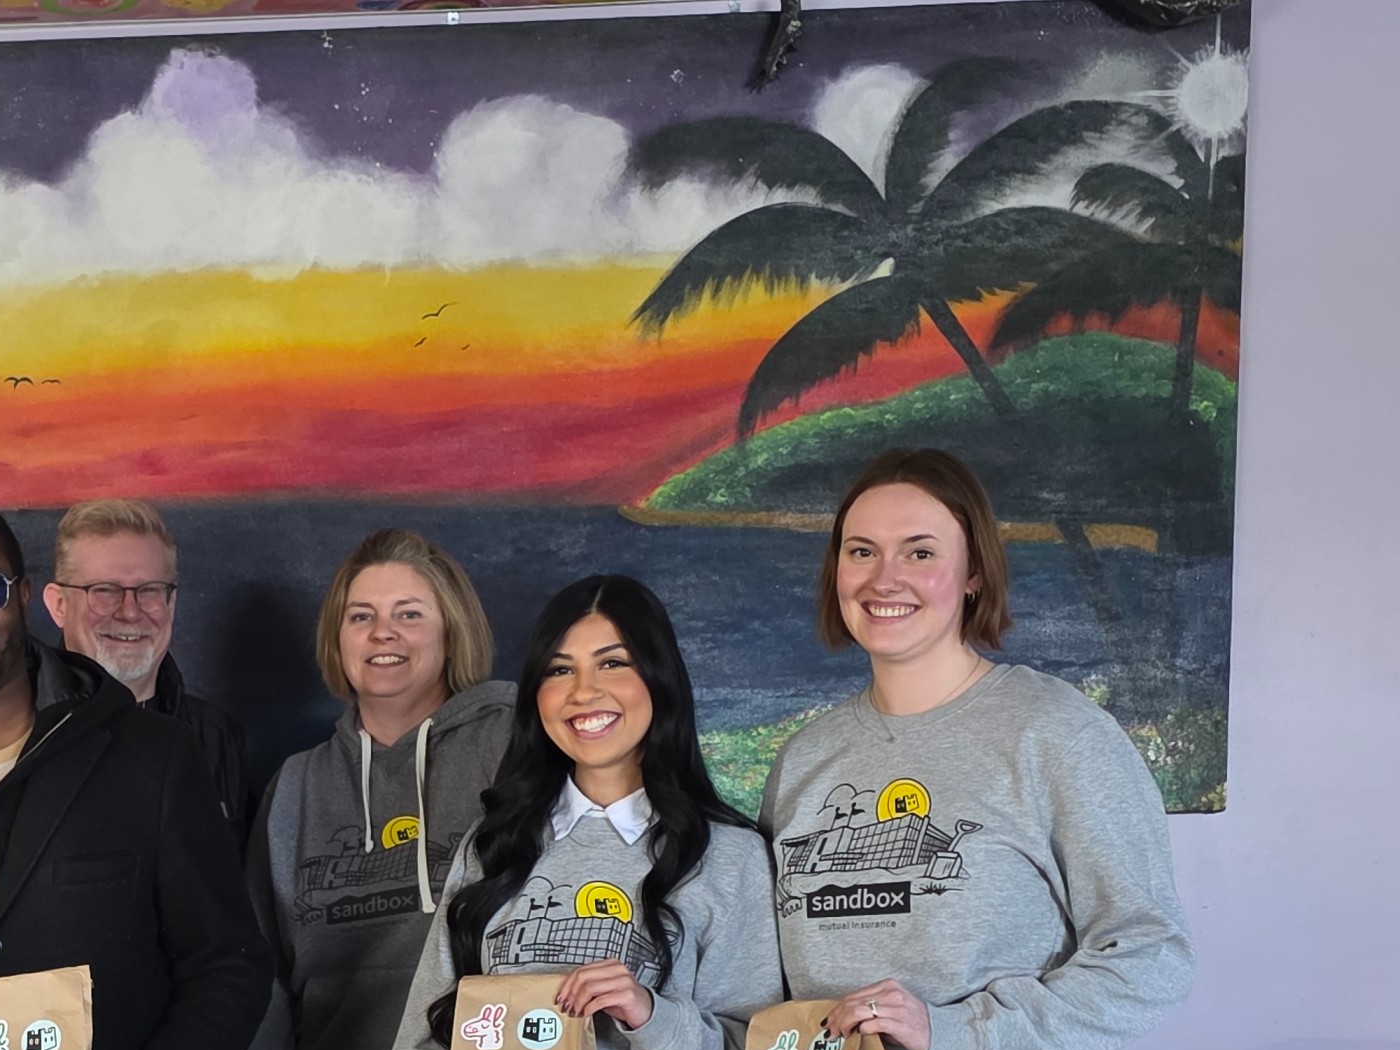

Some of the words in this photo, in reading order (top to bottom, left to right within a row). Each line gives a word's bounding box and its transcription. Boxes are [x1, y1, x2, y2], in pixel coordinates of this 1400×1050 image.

[332, 894, 414, 919] sandbox
[812, 888, 904, 911] sandbox
[818, 922, 849, 931] mutual
[852, 920, 896, 929] insurance
